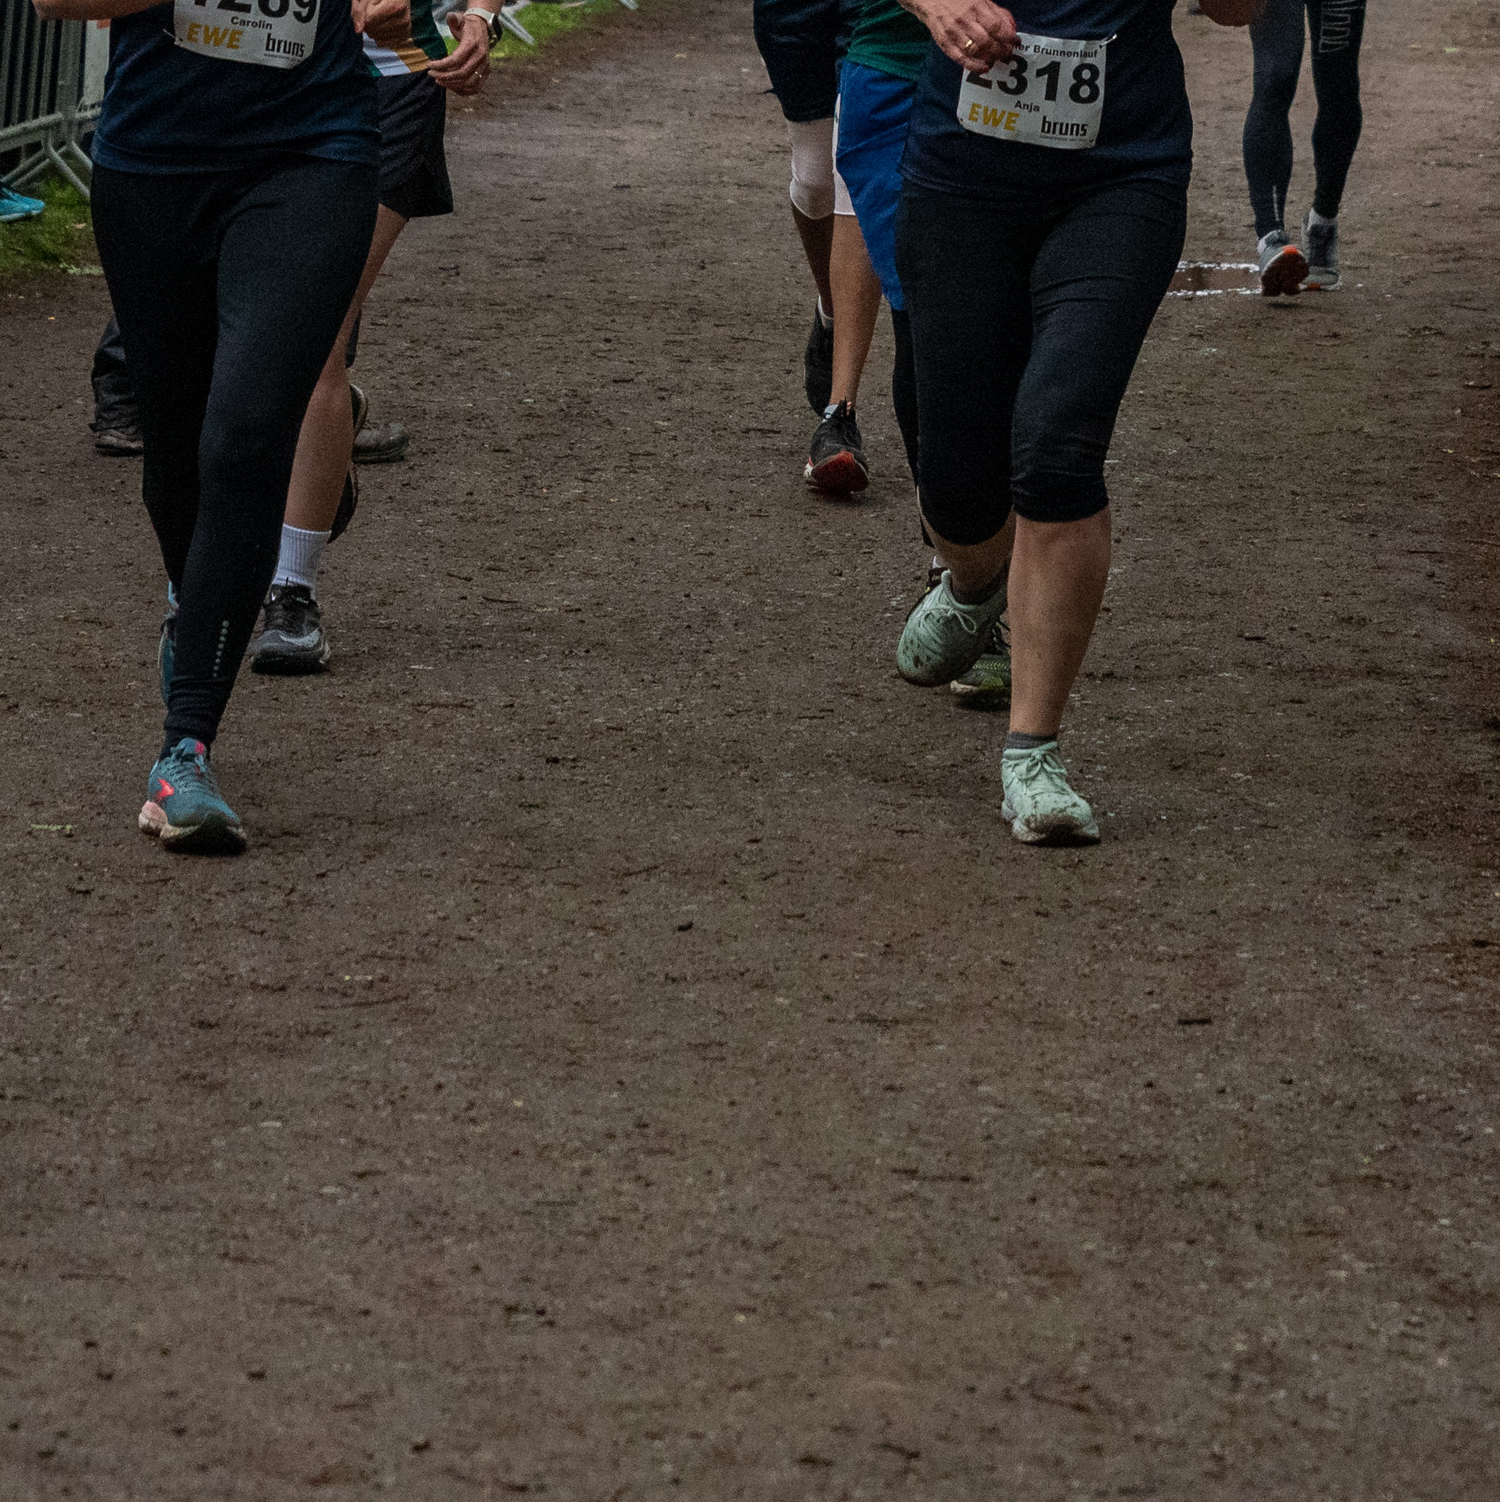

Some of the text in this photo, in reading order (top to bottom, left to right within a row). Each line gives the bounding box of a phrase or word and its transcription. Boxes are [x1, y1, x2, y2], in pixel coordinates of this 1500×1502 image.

[230, 15, 273, 31] Carolin
[187, 22, 244, 49] EWE
[265, 32, 306, 58] bruns
[1033, 44, 1098, 59] Brunnenlauf
[968, 102, 1020, 131] EWE
[1014, 100, 1041, 113] Anja
[1041, 115, 1089, 137] bruns
